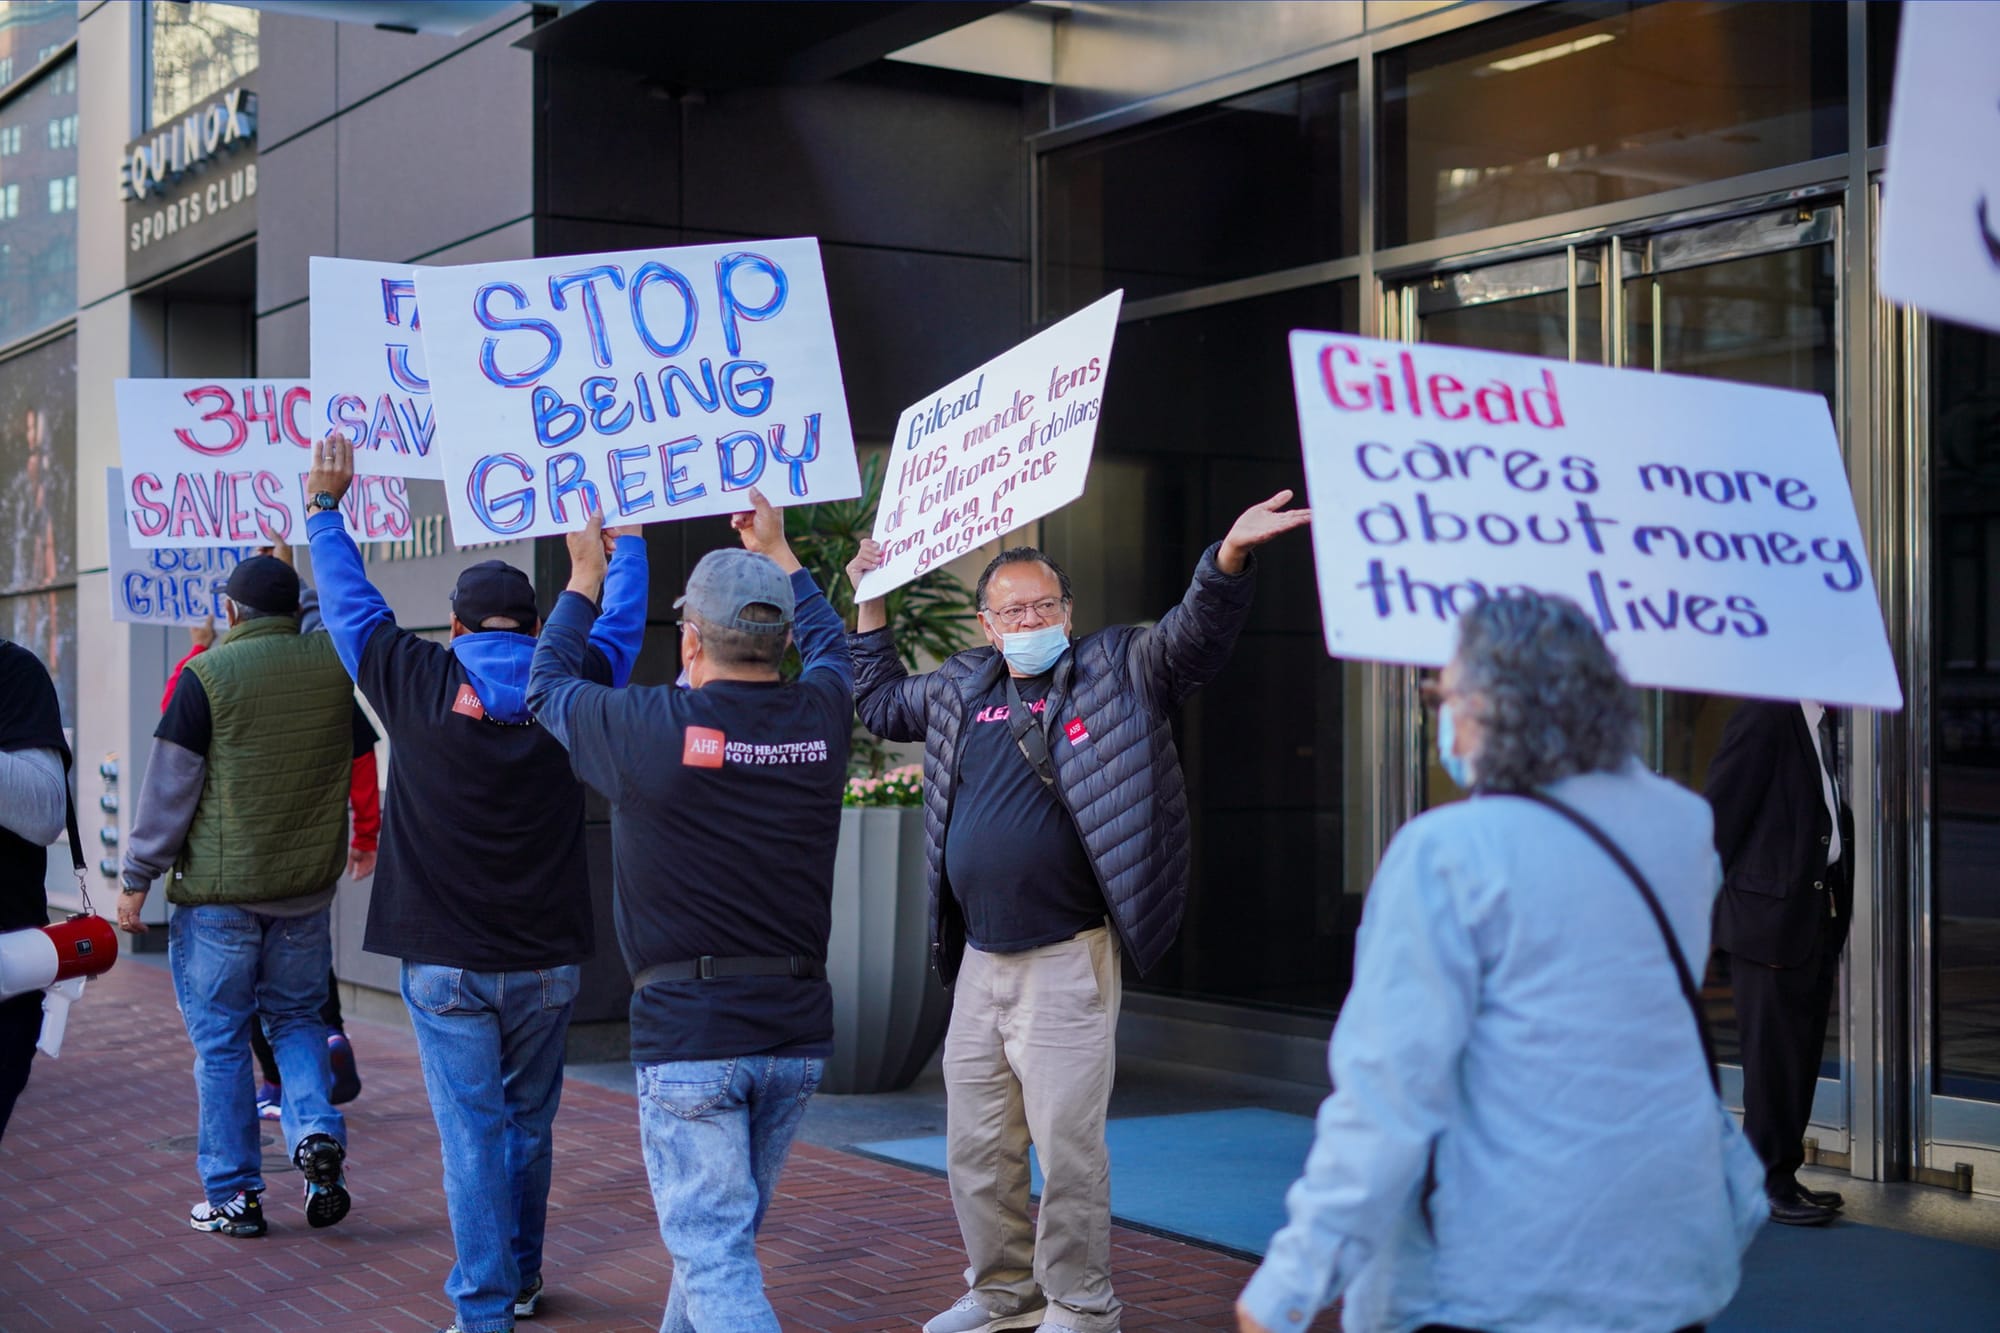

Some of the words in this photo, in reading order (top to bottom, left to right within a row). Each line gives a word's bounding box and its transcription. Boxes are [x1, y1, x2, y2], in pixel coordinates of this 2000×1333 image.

[117, 87, 241, 200] EQUINOX
[131, 192, 200, 251] SPORTS
[206, 164, 257, 215] CLUB
[473, 251, 788, 389] STOP
[532, 358, 774, 449] BEING
[906, 373, 984, 450] Gilead
[962, 390, 1034, 451] made
[1048, 357, 1101, 402] tens
[1319, 342, 1566, 429] Gilead
[132, 469, 292, 541] SAVES
[466, 412, 821, 535] GREEDY
[878, 528, 925, 569] from
[933, 496, 980, 535] drug
[991, 450, 1058, 513] price
[884, 495, 910, 533] of
[918, 446, 1011, 516] billions
[1355, 440, 1599, 494] cares
[1638, 461, 1818, 511] more
[914, 507, 1014, 575] gouging
[1356, 492, 1619, 554] about
[1632, 524, 1864, 593] money
[1587, 570, 1768, 638] lives
[690, 739, 719, 754] AHF
[725, 741, 752, 753] AIDS
[754, 740, 827, 756] HEALTHCARE
